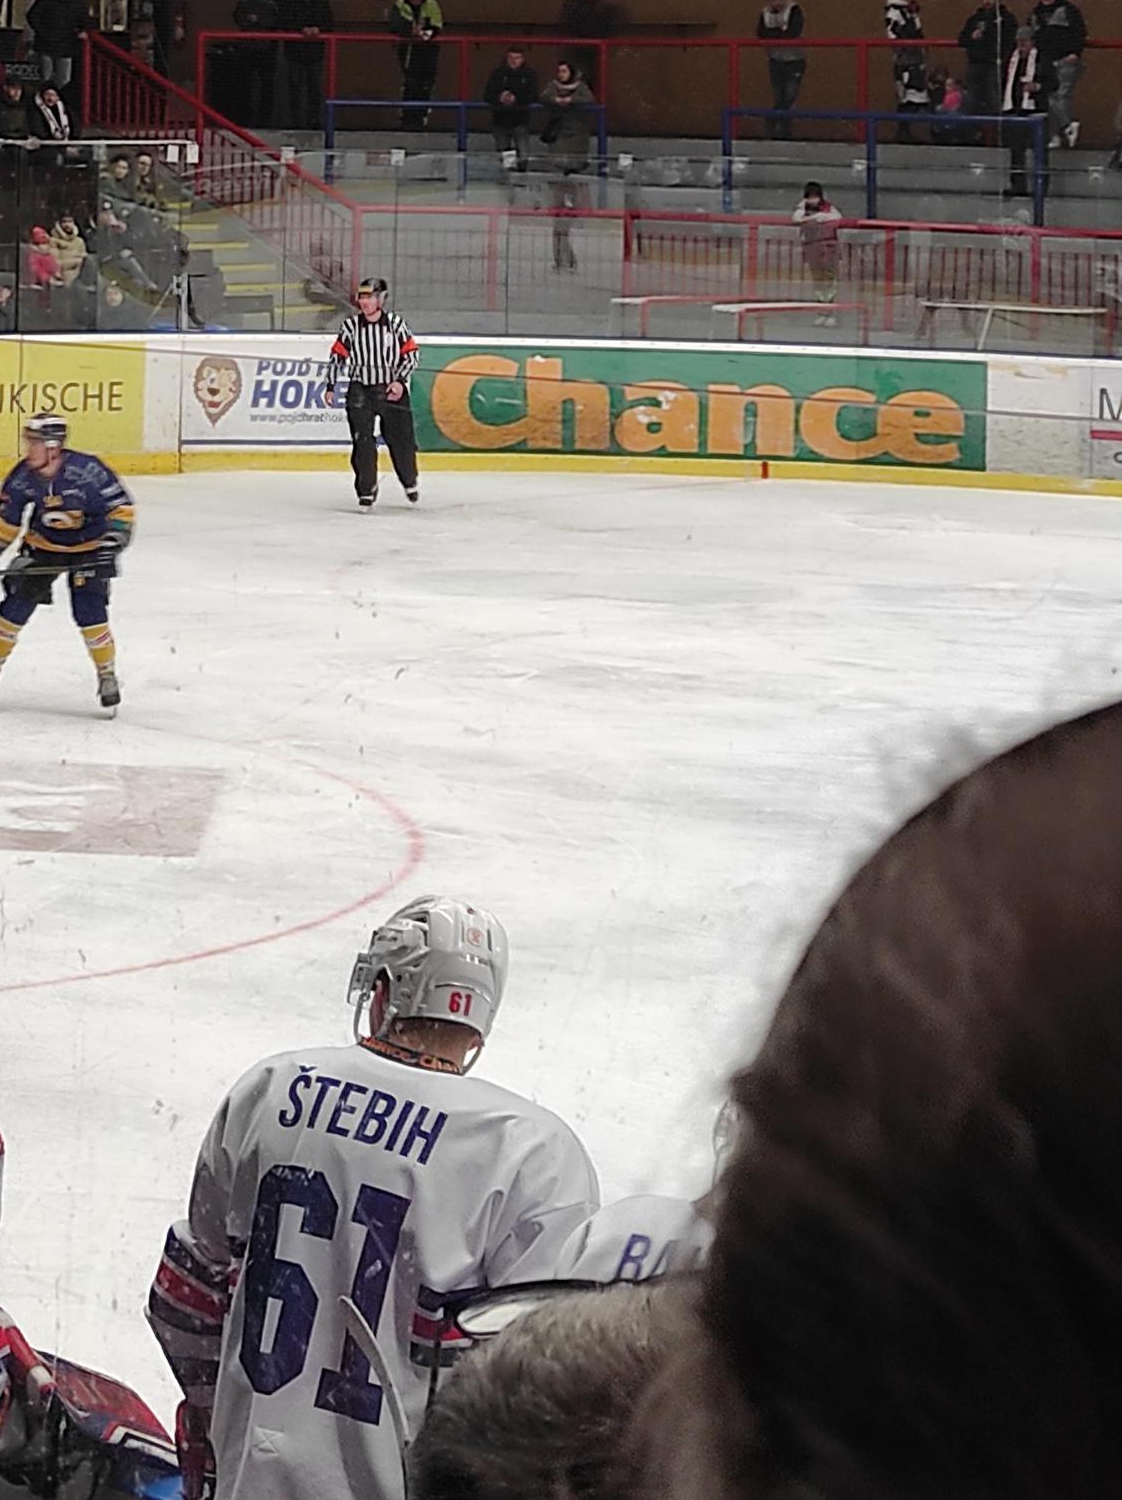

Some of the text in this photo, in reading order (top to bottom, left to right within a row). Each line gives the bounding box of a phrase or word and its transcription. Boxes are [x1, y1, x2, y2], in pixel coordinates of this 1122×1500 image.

[250, 379, 350, 409] HOKE
[430, 354, 966, 464] Chance
[449, 991, 473, 1017] 61
[278, 1065, 450, 1166] ŠTEBIH
[239, 1163, 412, 1426] 61
